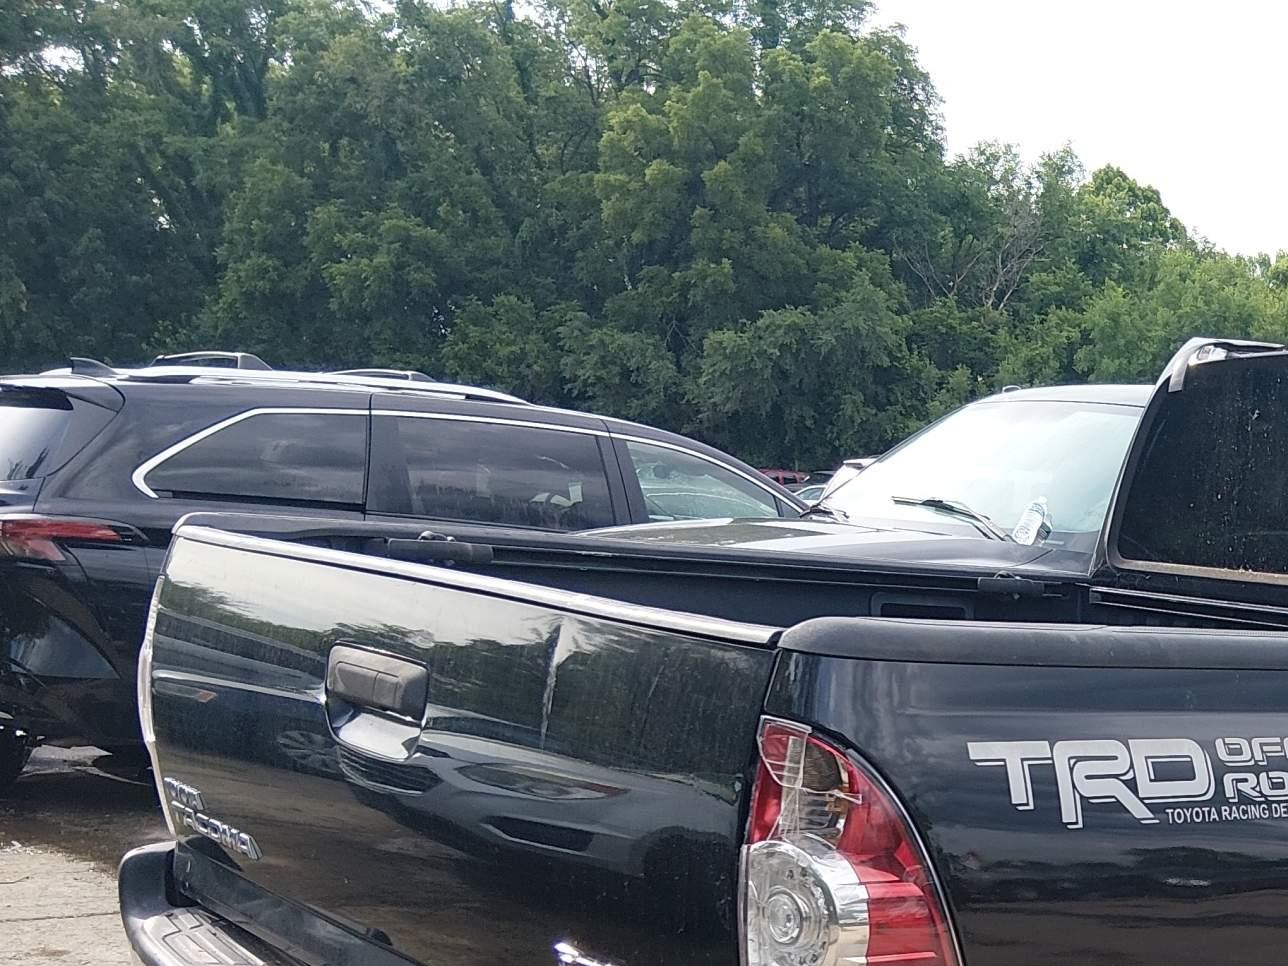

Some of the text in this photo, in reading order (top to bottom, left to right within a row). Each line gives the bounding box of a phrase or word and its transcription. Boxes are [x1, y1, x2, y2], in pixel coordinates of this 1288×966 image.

[967, 738, 1215, 829] TRD
[1166, 807, 1219, 825] TOYOTA
[1221, 803, 1269, 821] RACING
